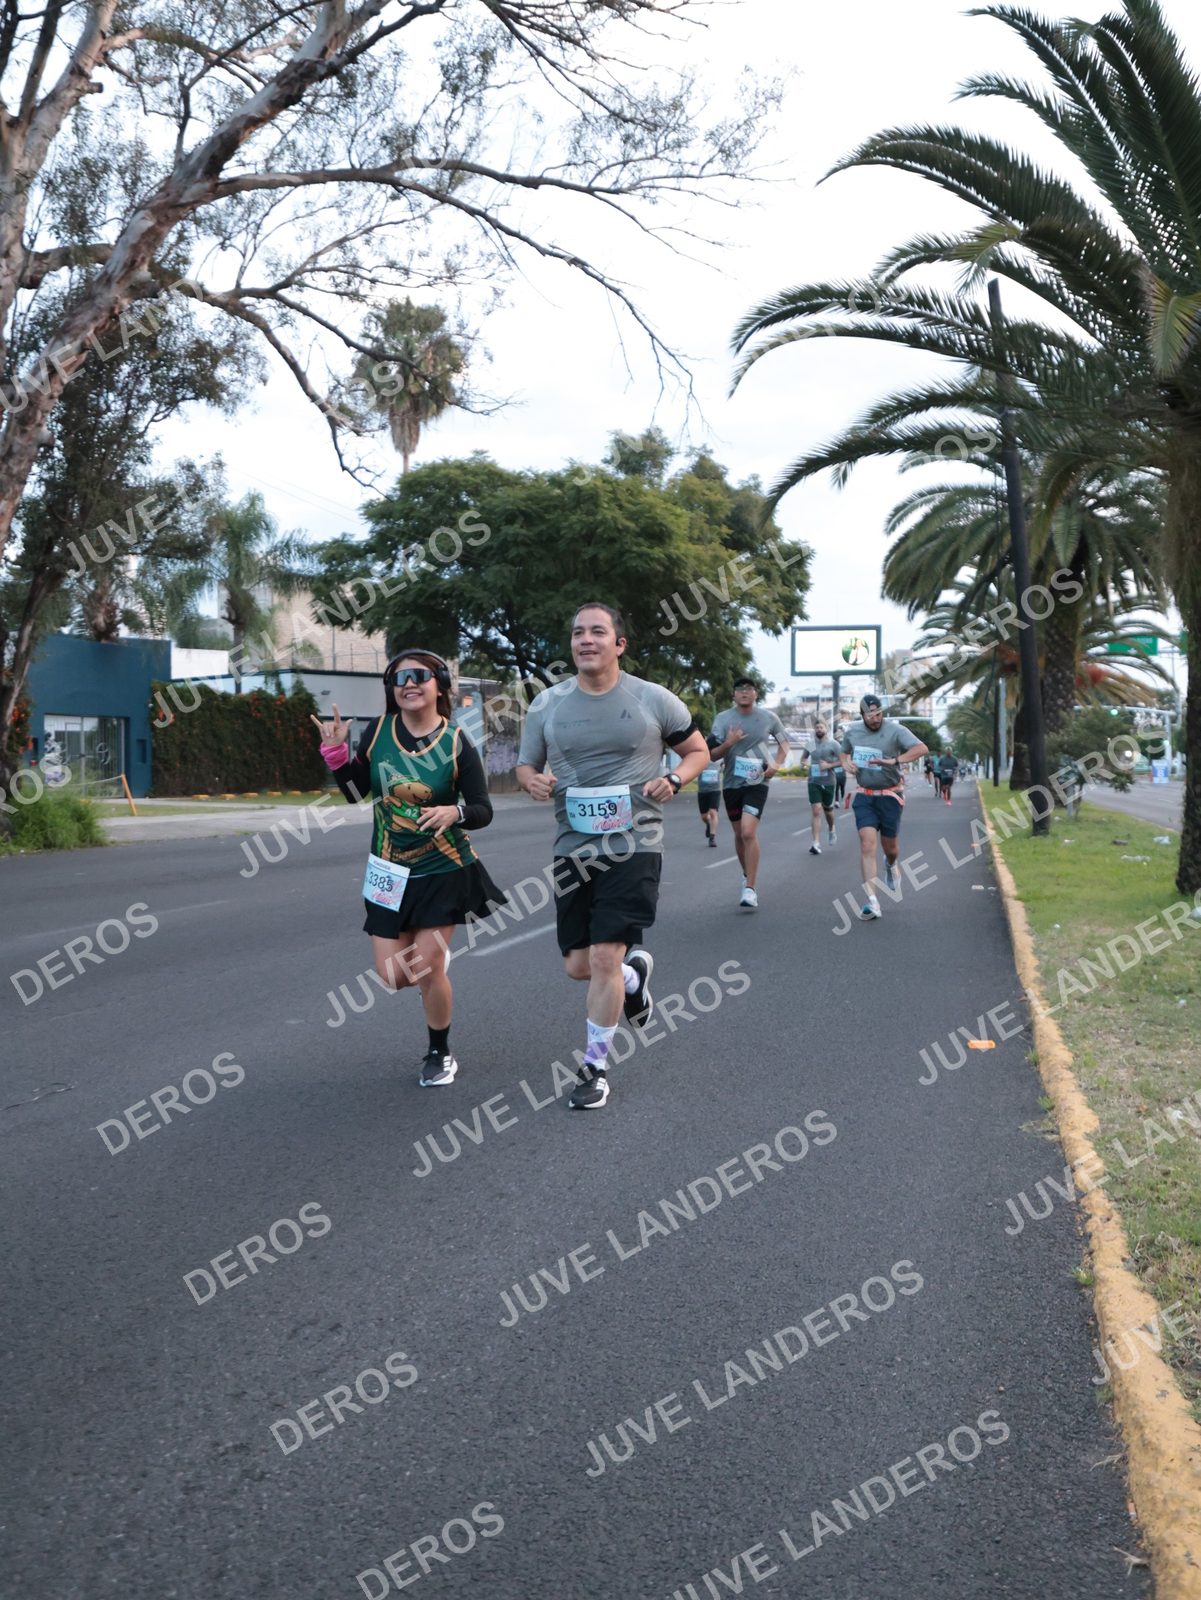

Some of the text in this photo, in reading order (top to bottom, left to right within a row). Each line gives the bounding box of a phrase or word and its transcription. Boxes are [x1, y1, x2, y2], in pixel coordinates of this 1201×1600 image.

[404, 807, 418, 818] 42
[577, 802, 618, 817] 3159
[368, 871, 394, 892] 3385
